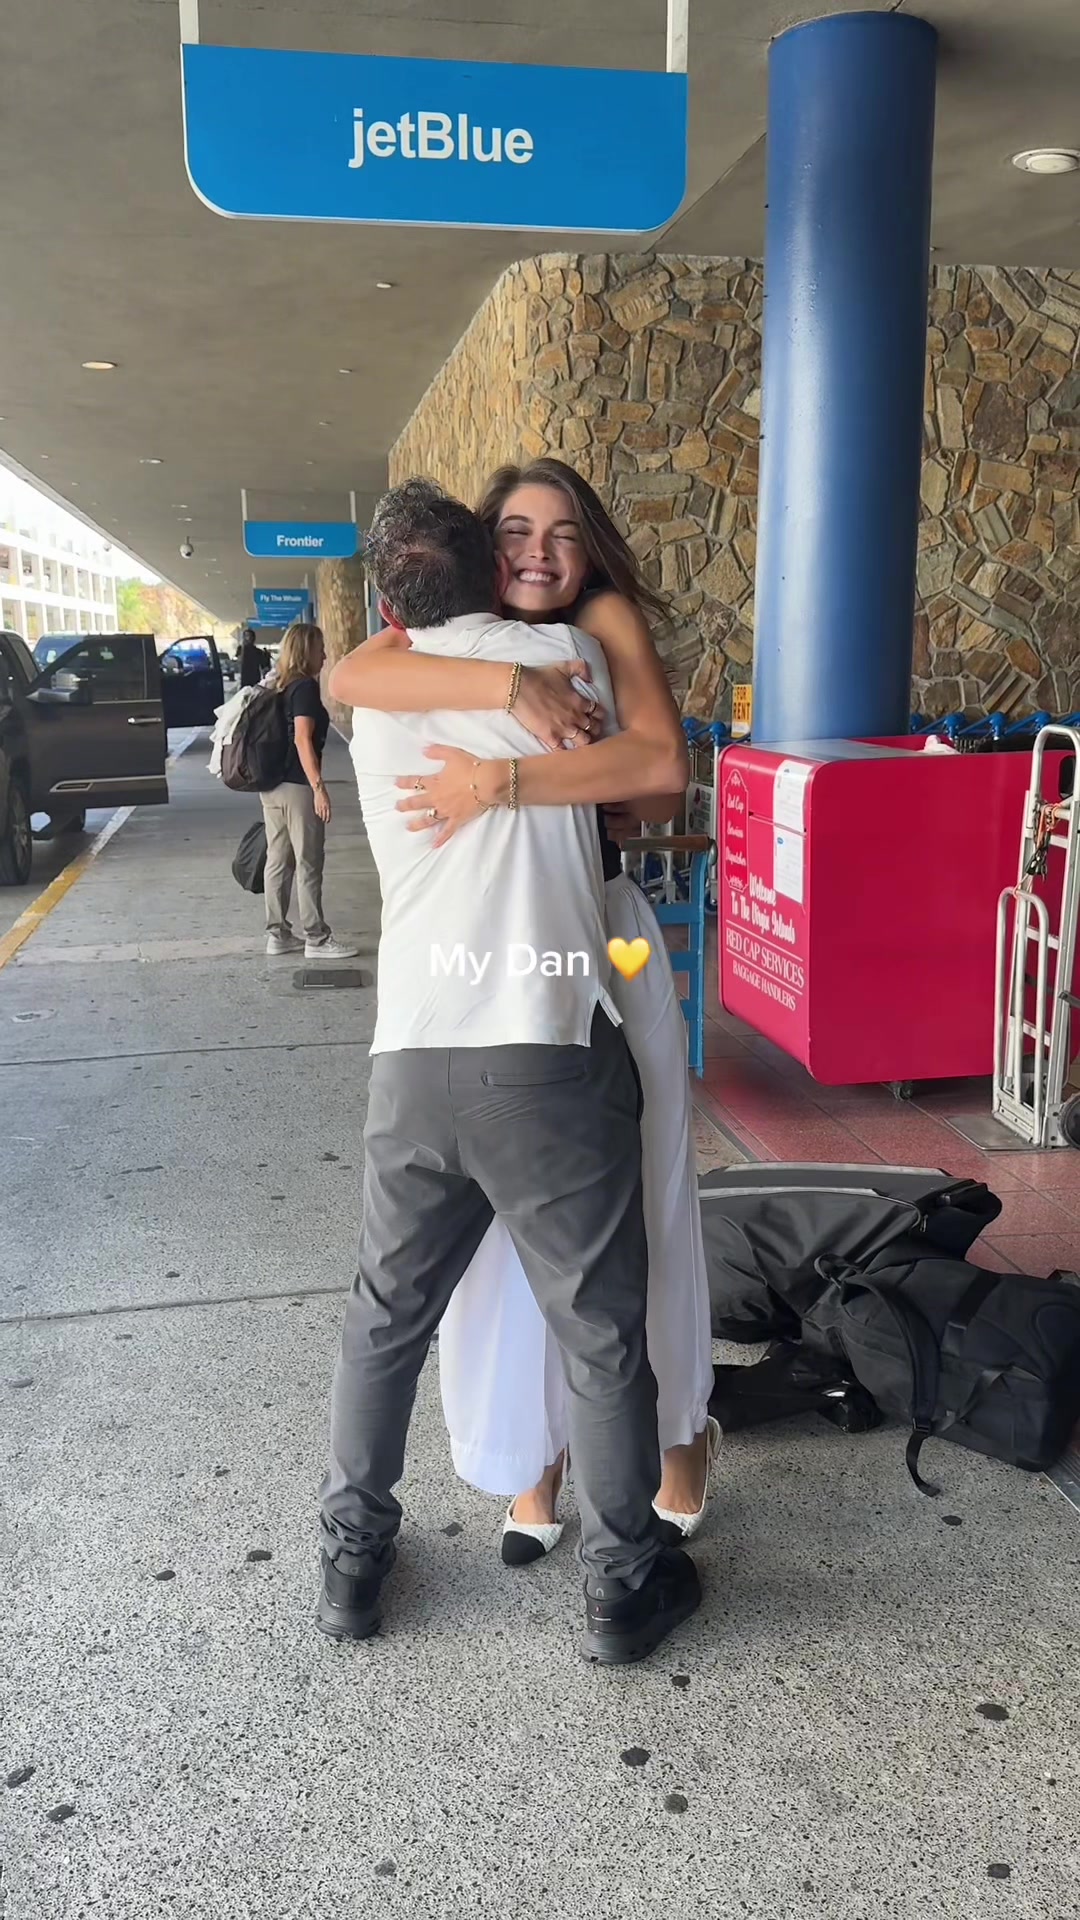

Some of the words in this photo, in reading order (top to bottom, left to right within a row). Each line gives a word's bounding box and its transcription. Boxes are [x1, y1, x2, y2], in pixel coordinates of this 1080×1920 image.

[348, 108, 534, 168] jetBlue
[276, 534, 324, 547] Frontier
[260, 594, 269, 603] Fly
[736, 686, 747, 700] FOR
[733, 702, 751, 720] RENT
[749, 872, 776, 907] Welcome
[731, 890, 739, 916] To
[740, 895, 750, 921] The
[751, 901, 770, 934] Virgin
[771, 910, 796, 944] Islands
[726, 928, 742, 951] RED
[743, 937, 760, 961] CAP
[761, 947, 804, 988] SERVICES
[733, 959, 760, 990] BAGGAGE
[761, 978, 796, 1011] HANDLERS
